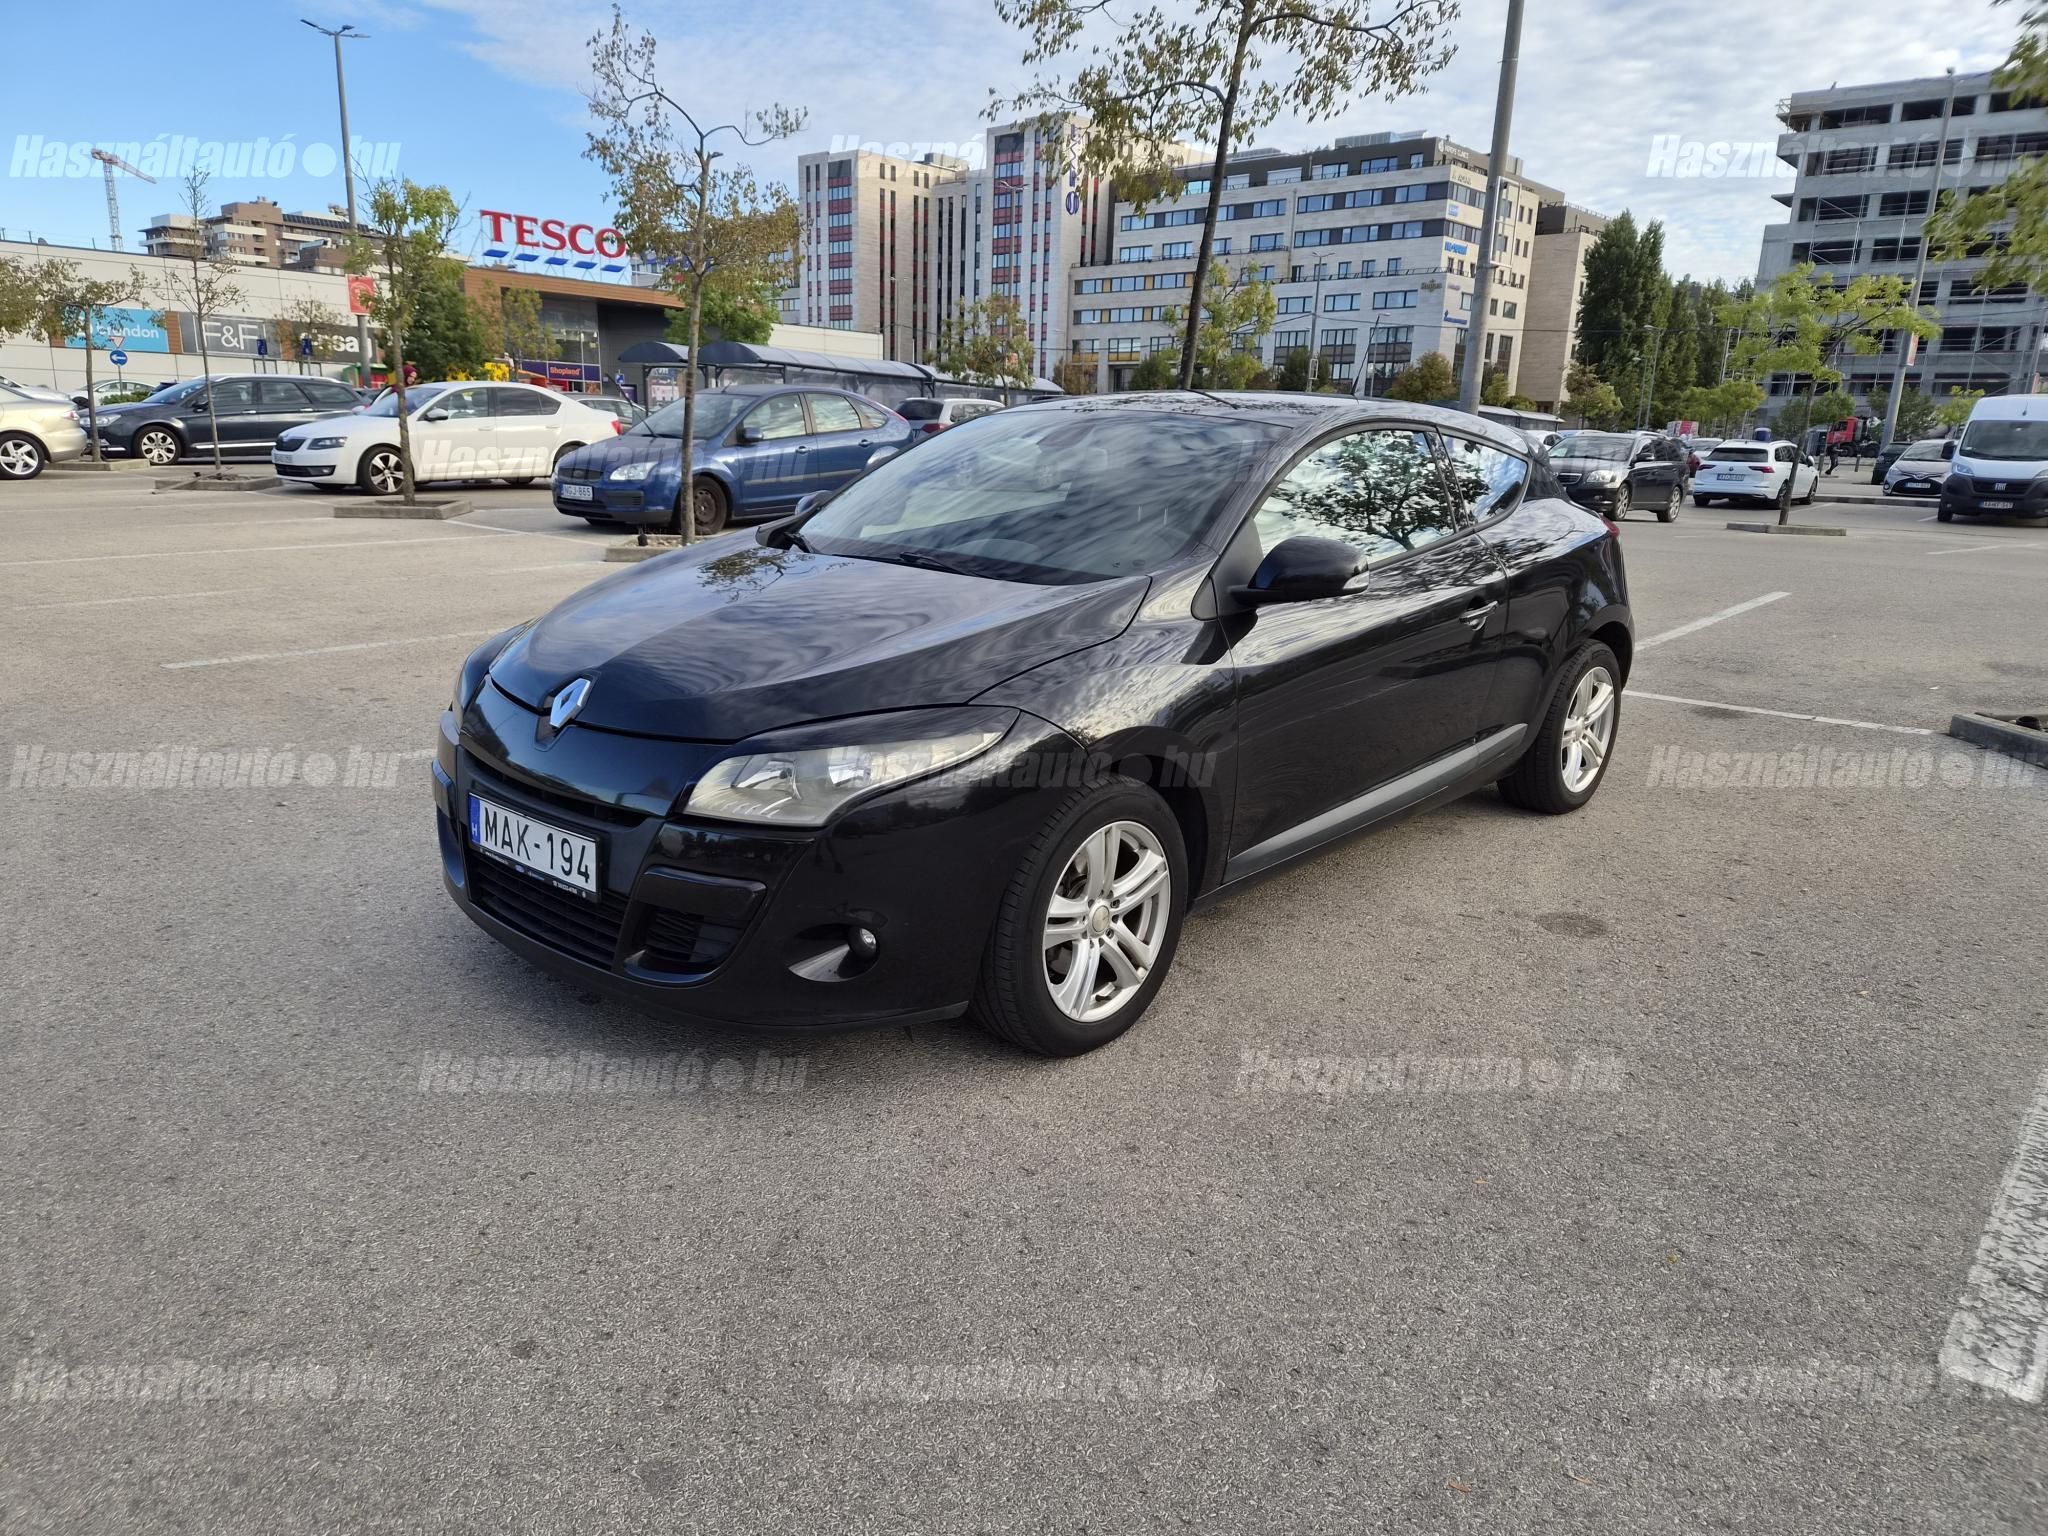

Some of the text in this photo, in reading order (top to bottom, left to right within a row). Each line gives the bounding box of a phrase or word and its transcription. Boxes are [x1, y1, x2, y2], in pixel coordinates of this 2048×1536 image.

[480, 209, 627, 259] TESCO
[202, 321, 259, 350] F&F
[484, 806, 590, 884] MAK-194
